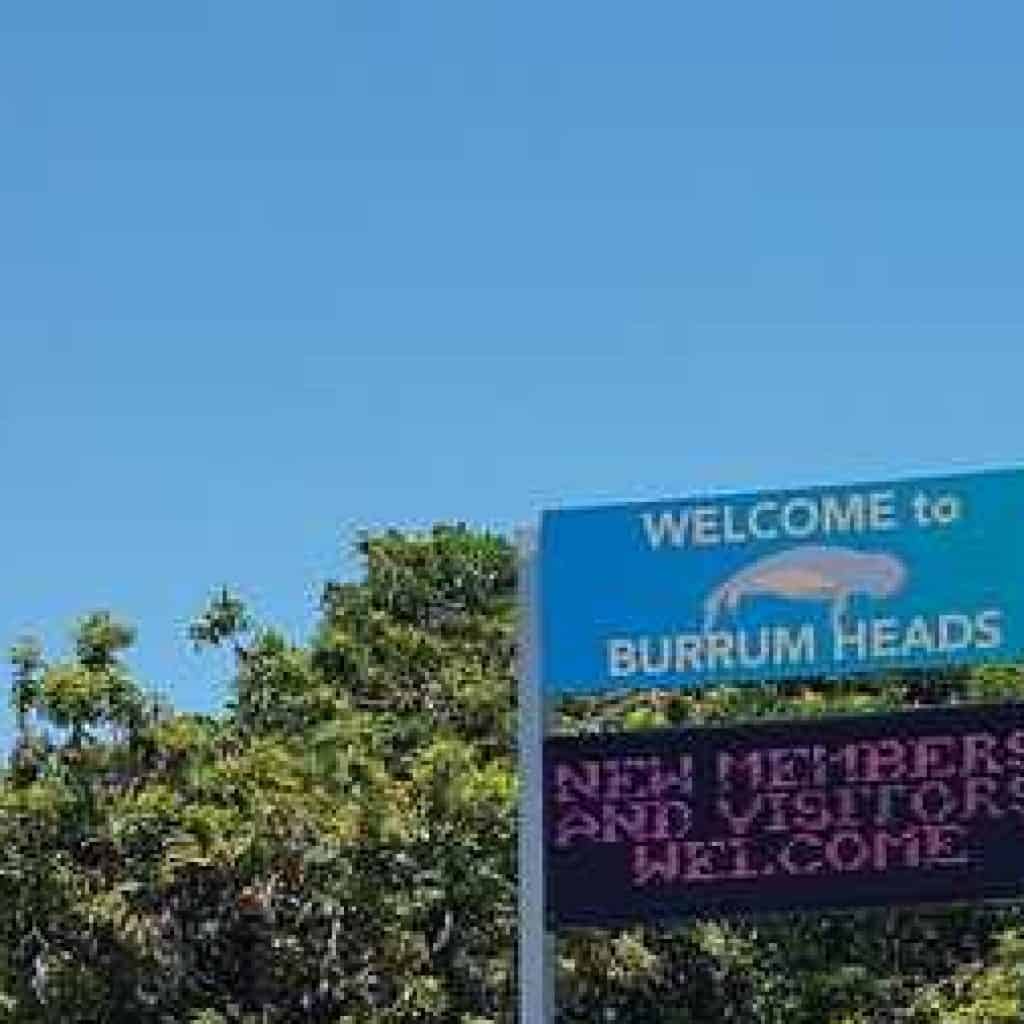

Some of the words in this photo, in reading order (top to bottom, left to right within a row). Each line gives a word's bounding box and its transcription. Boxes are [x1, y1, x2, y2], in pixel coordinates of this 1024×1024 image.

[643, 491, 896, 548] WELCOME
[914, 490, 960, 526] to
[607, 624, 815, 676] BURRUM
[834, 611, 1002, 661] HEADS
[556, 754, 693, 802] NEW
[556, 800, 692, 846] AND
[631, 825, 969, 884] WELCOME
